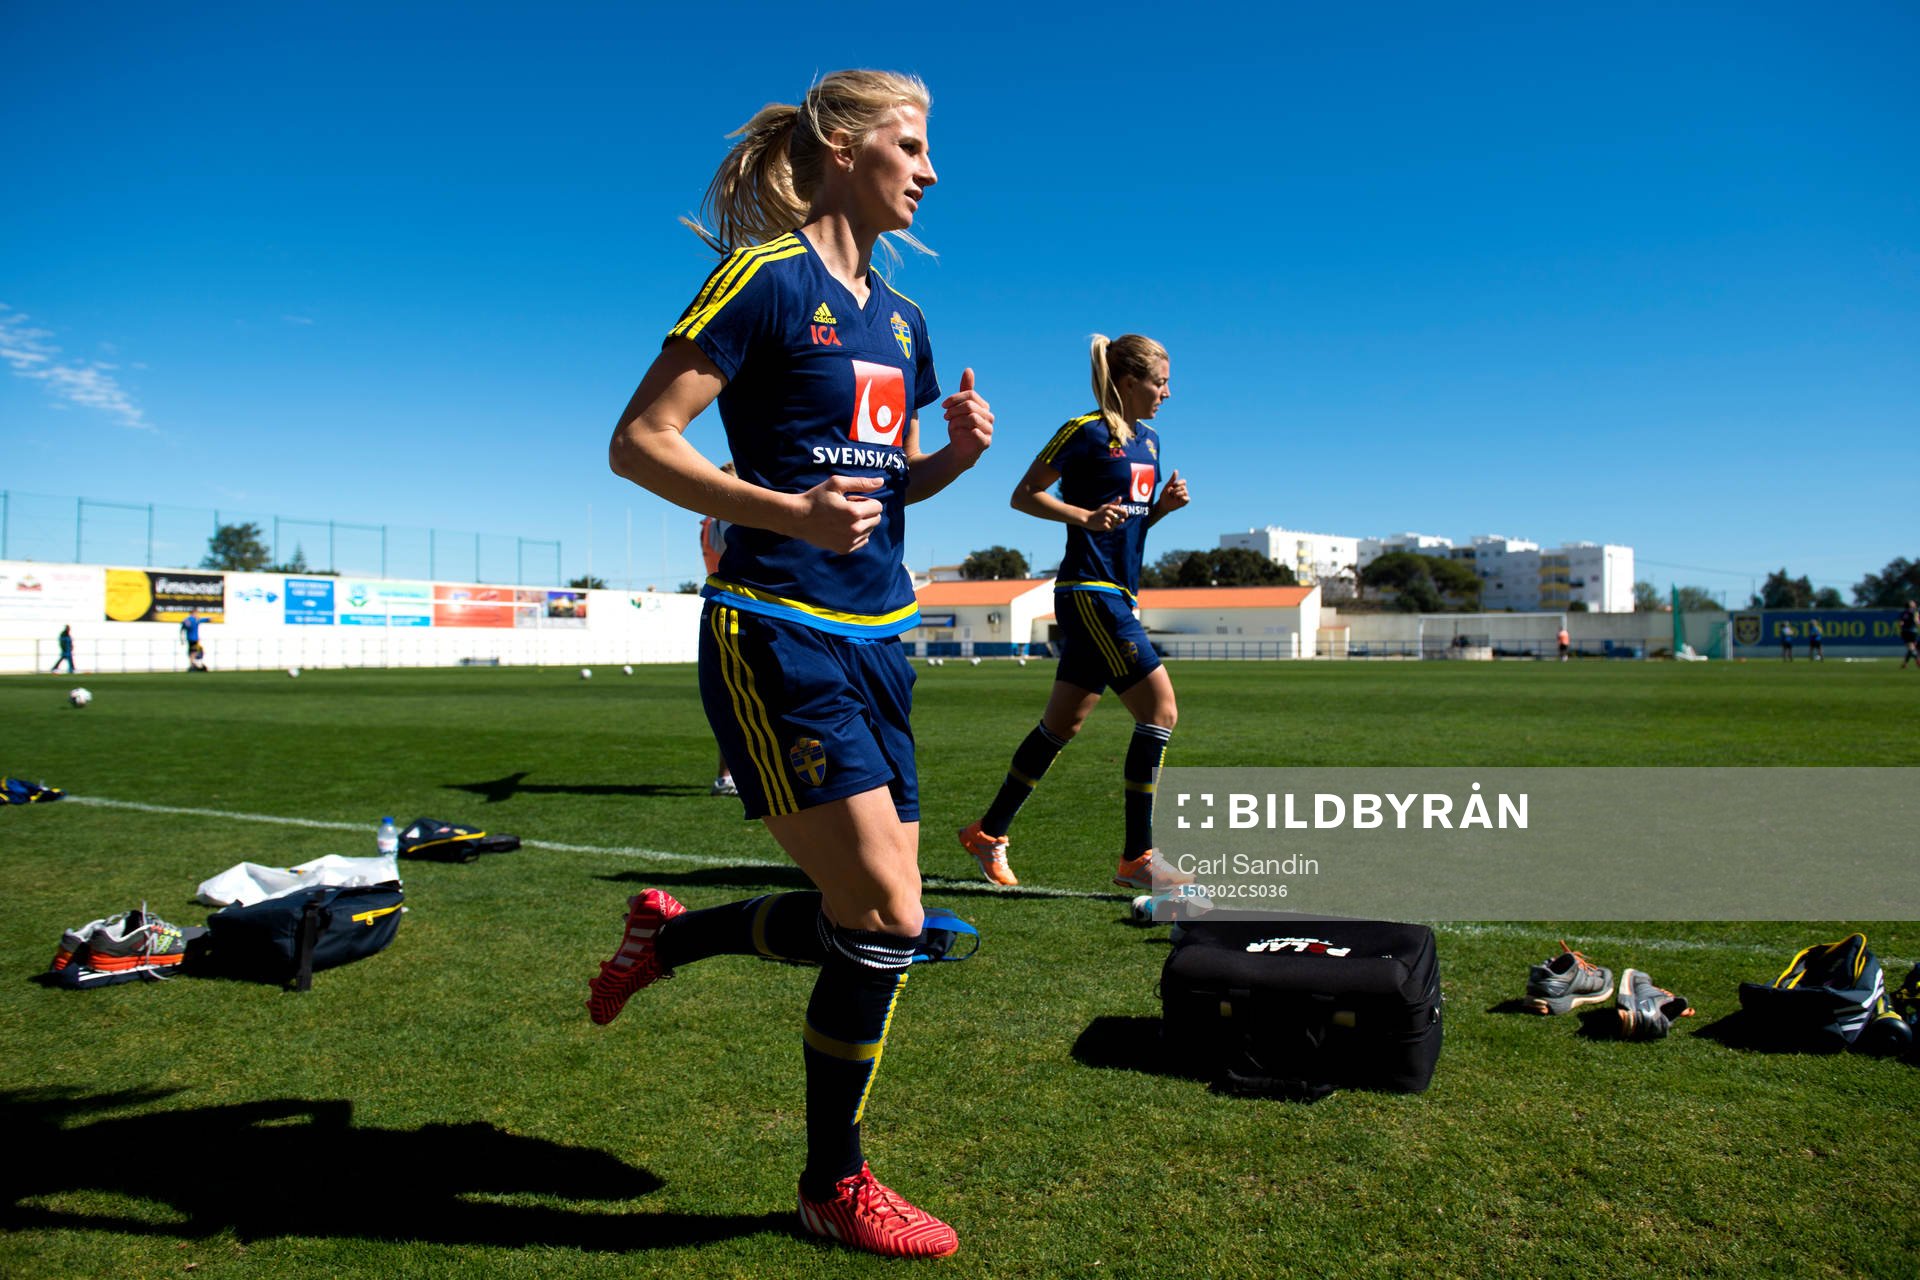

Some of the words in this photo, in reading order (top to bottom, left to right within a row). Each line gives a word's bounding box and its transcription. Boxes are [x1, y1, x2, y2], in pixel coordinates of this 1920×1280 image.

[813, 315, 837, 324] adidas
[810, 325, 842, 345] ICA
[1246, 942, 1351, 957] POLAR
